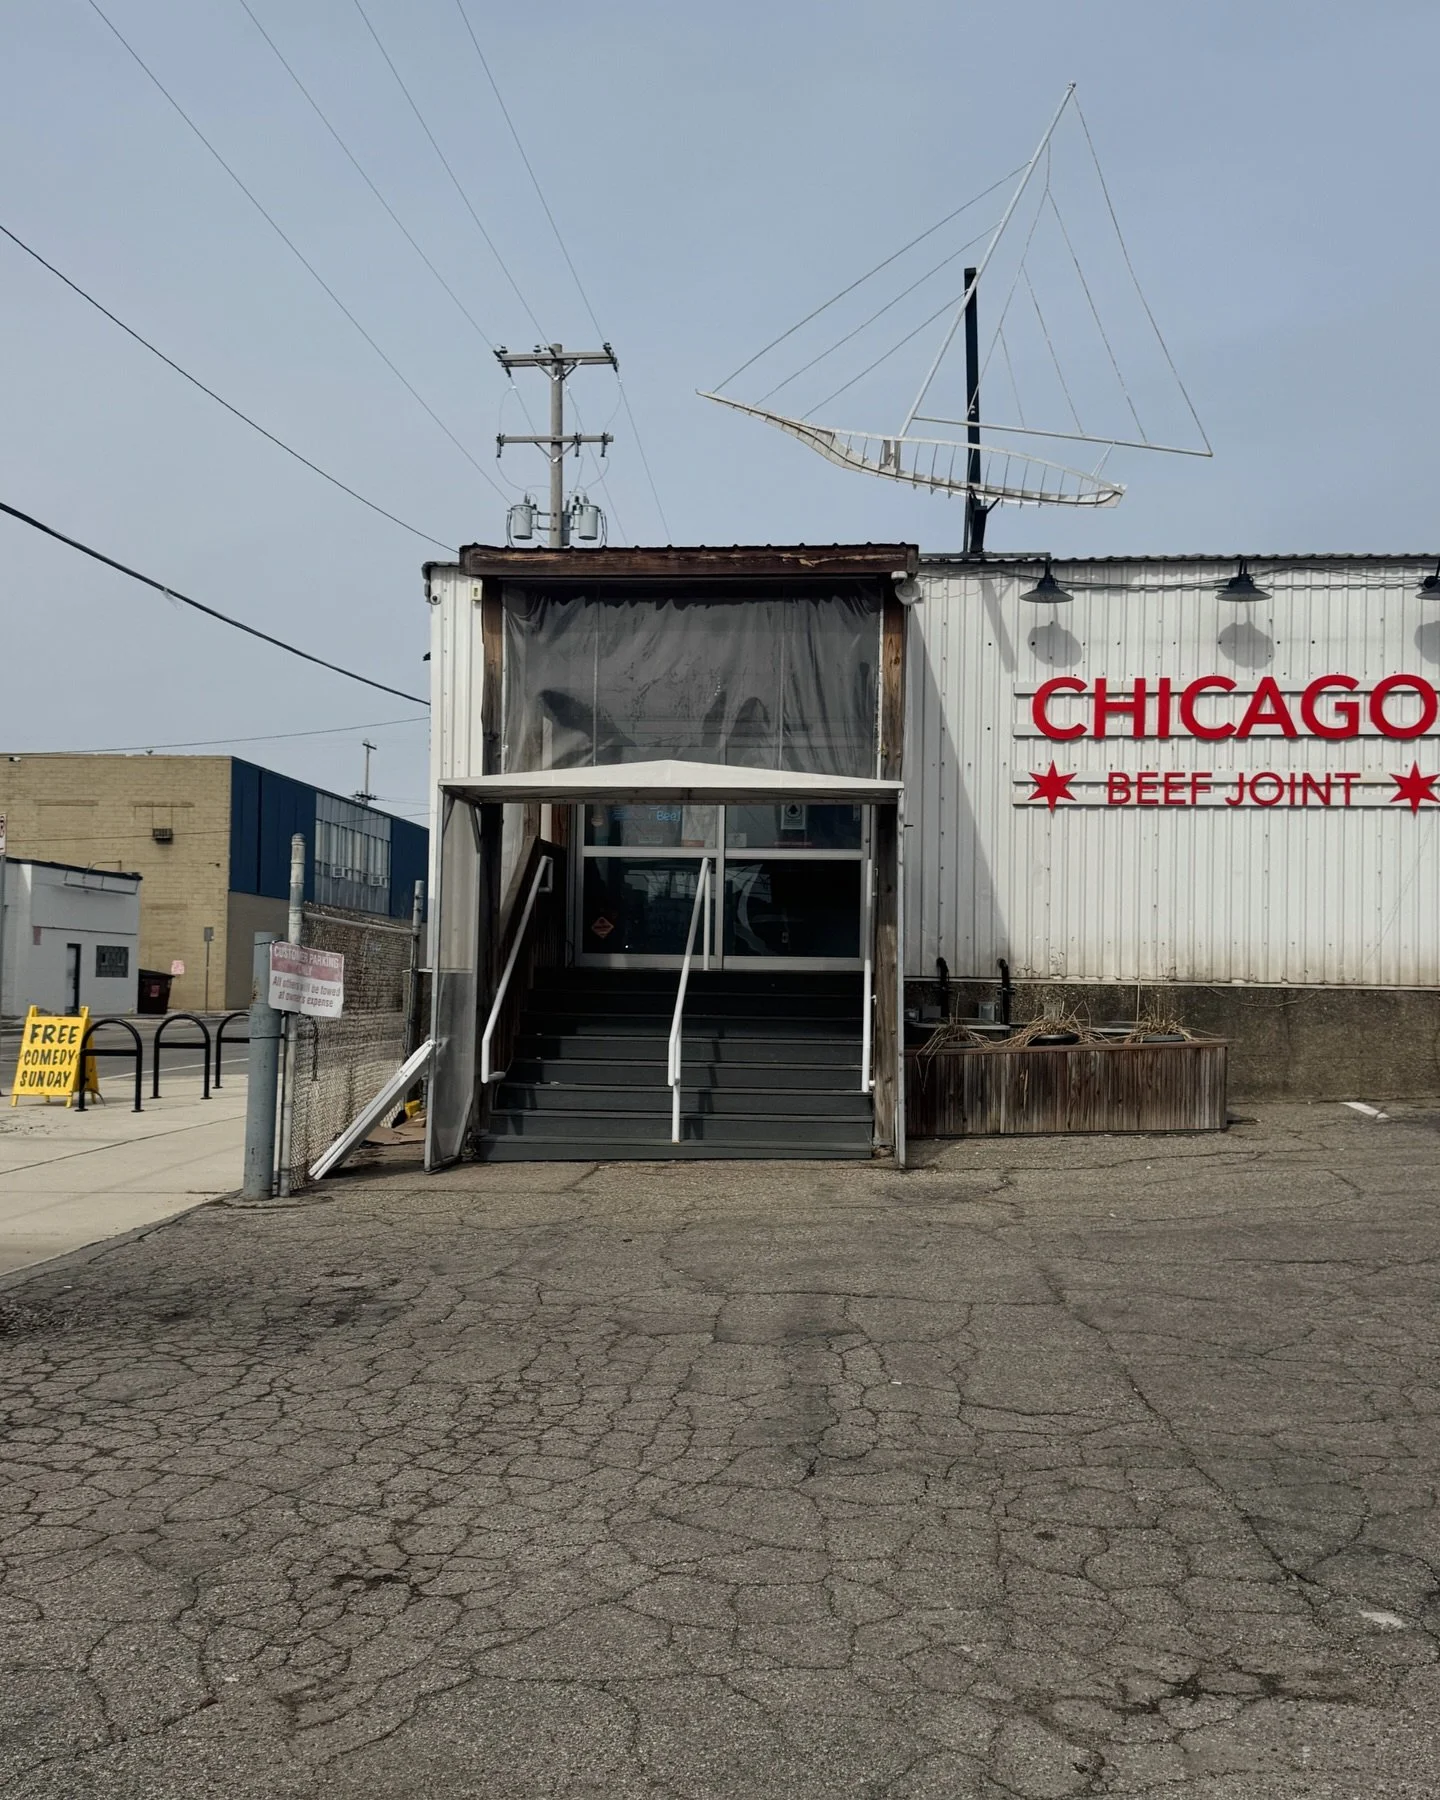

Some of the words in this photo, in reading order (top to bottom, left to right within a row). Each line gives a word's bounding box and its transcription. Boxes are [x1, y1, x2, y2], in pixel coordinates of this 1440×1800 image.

[1032, 674, 1438, 740] CHICAGO
[1107, 772, 1212, 806] BEEF
[1225, 771, 1361, 806] JOINT
[274, 946, 309, 962] CUSTOMER
[309, 953, 339, 969] PARKING
[278, 990, 285, 999] at
[307, 996, 334, 1007] expense
[311, 984, 319, 994] be
[320, 985, 341, 996] towed
[30, 1023, 80, 1044] FREE
[24, 1049, 76, 1065] COMEDY
[20, 1070, 72, 1087] SUNDAY
